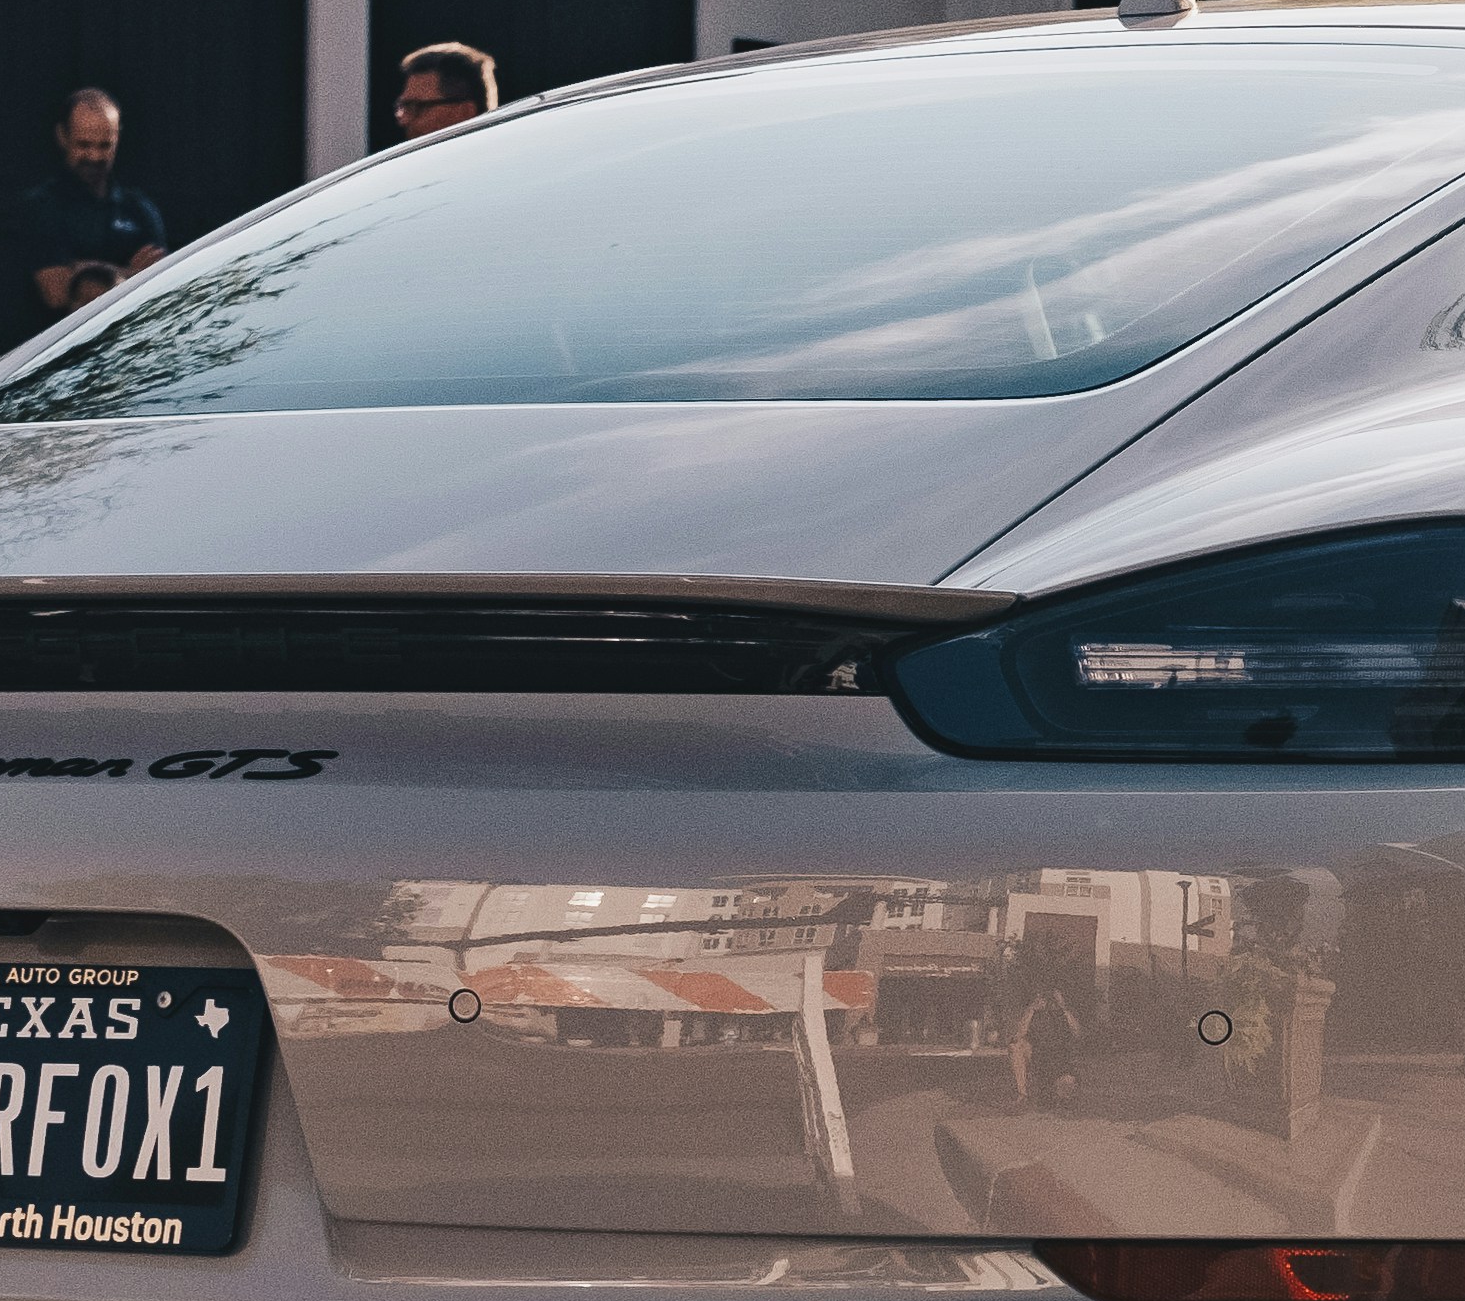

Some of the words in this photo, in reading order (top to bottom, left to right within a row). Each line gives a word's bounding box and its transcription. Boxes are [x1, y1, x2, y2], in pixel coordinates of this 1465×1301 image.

[148, 749, 341, 781] GTS
[5, 967, 61, 984] AUTO
[68, 968, 140, 986] GROUP
[50, 1204, 183, 1245] Houston
